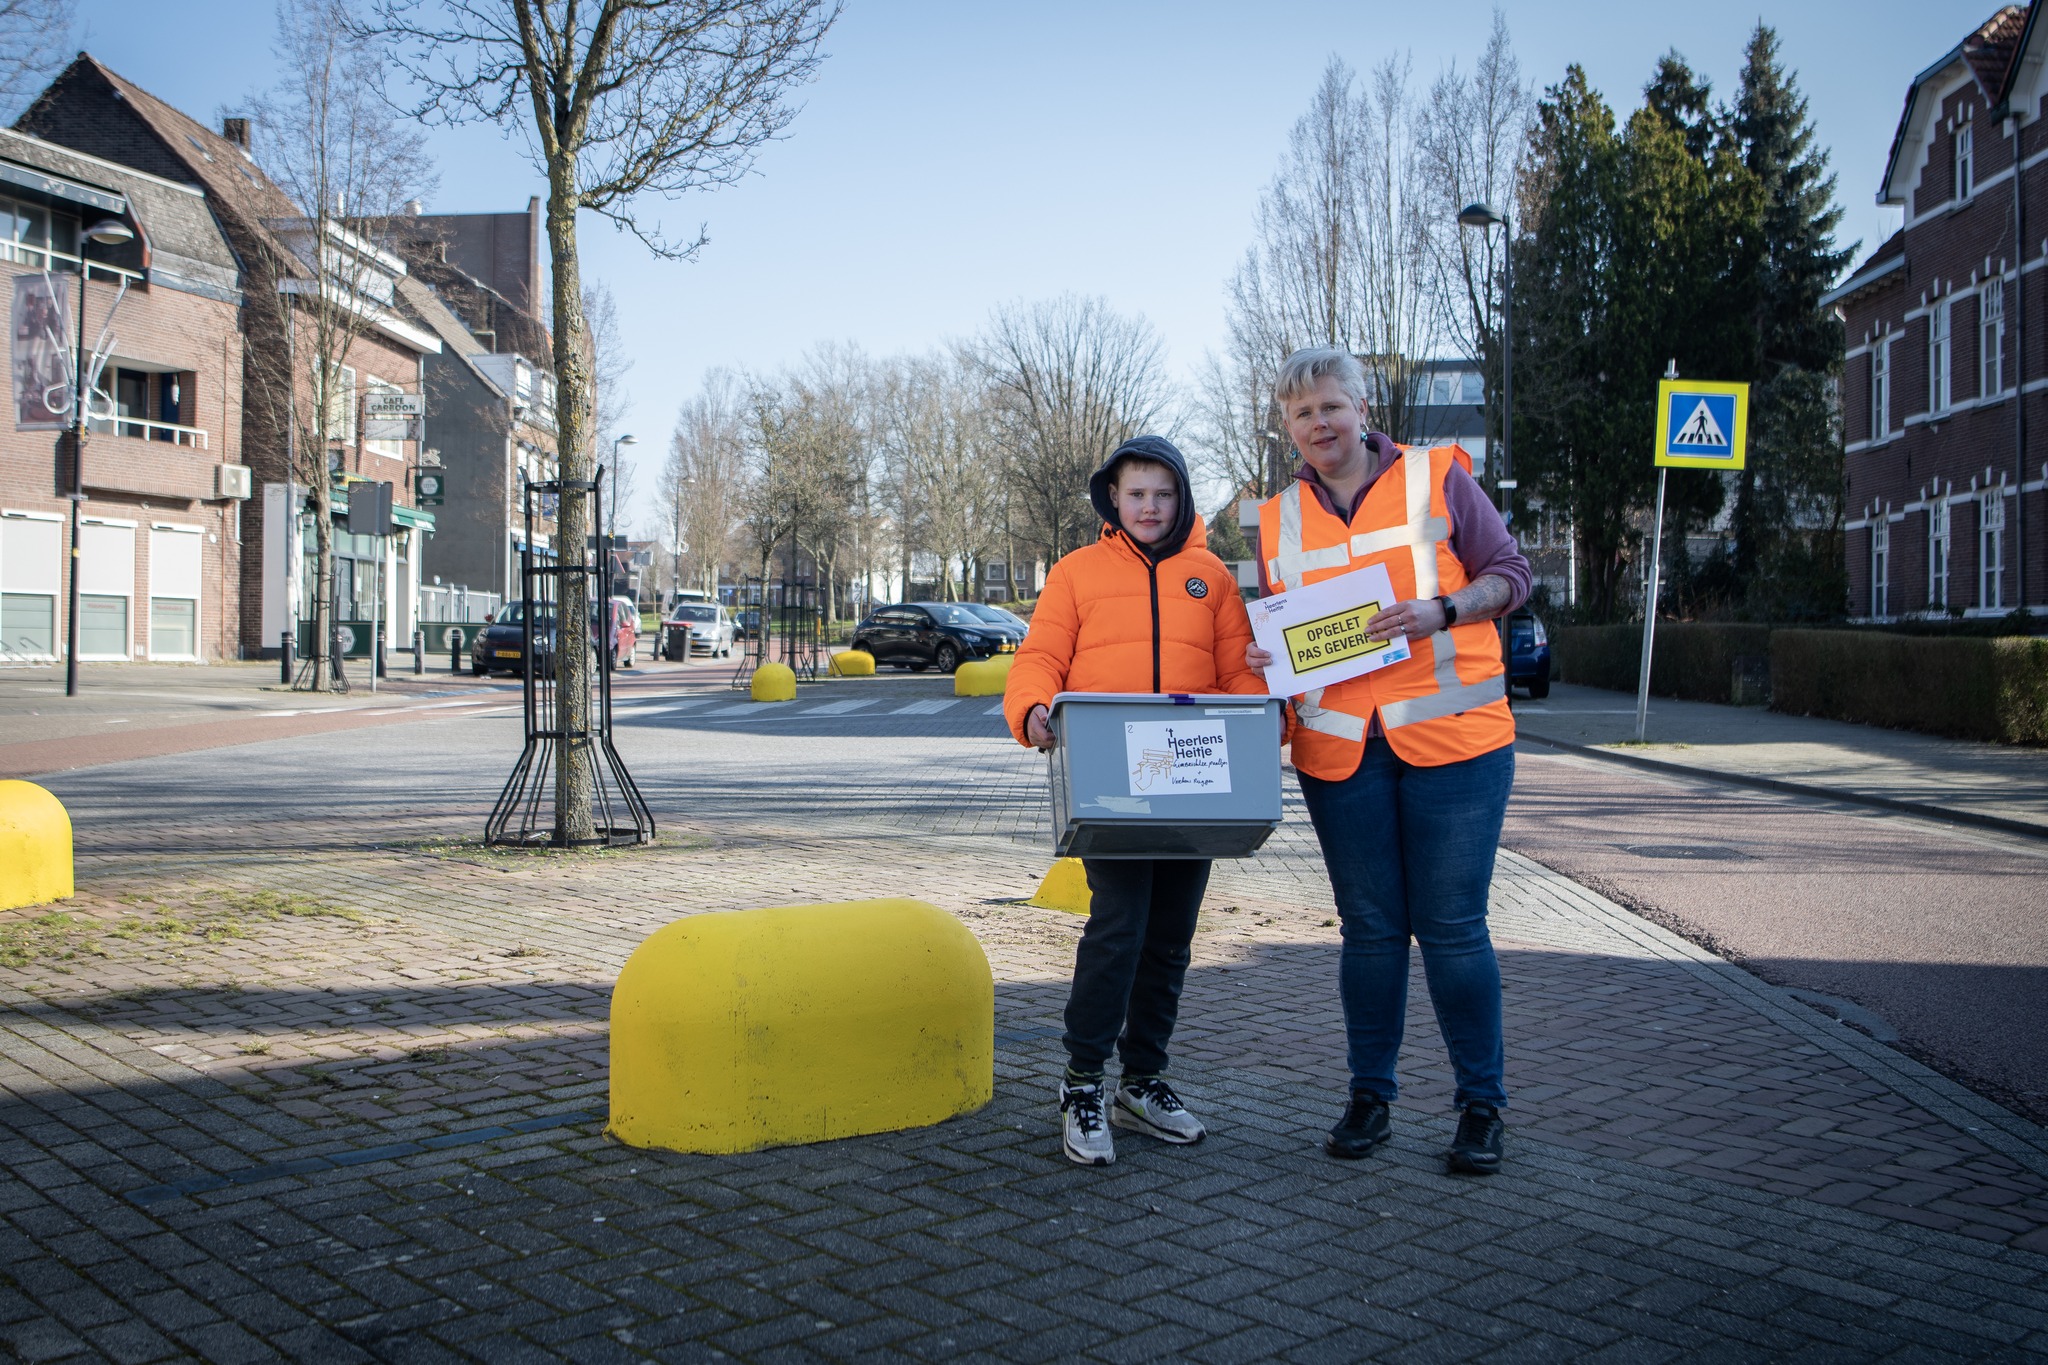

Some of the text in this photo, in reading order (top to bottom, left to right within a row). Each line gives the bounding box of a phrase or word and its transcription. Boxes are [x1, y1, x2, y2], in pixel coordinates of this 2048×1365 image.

[1307, 616, 1360, 642] OPGELET
[1297, 646, 1322, 662] PAS
[1127, 724, 1134, 733] 2
[1167, 735, 1223, 748] Heerlens
[1176, 746, 1212, 759] Heitje
